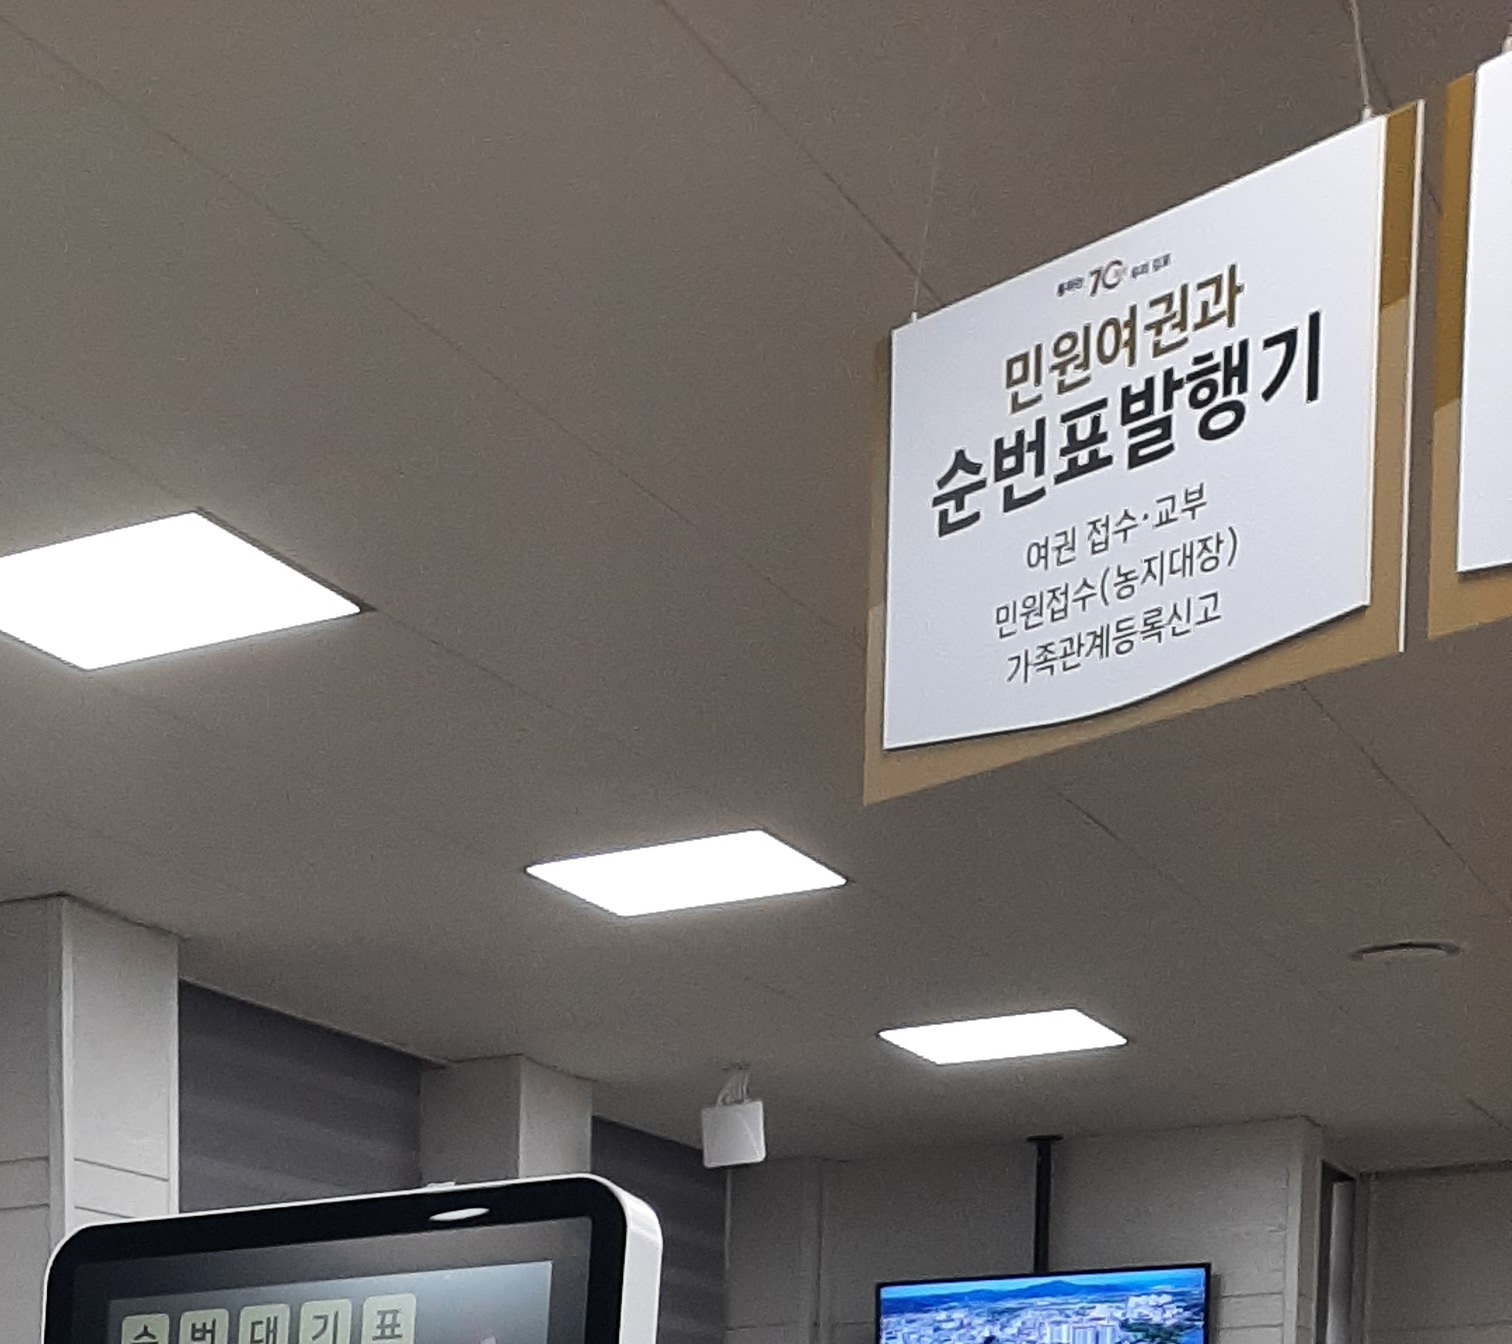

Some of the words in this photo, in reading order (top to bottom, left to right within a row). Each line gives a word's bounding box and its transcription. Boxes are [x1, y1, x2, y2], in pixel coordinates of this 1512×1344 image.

[1005, 263, 1245, 414] 민원여권과
[930, 308, 1322, 538] 순번표발행기
[994, 526, 1240, 638] 민원접수(농지대장)
[1025, 525, 1077, 570] 여권
[1004, 591, 1223, 684] 가족관계등록신고
